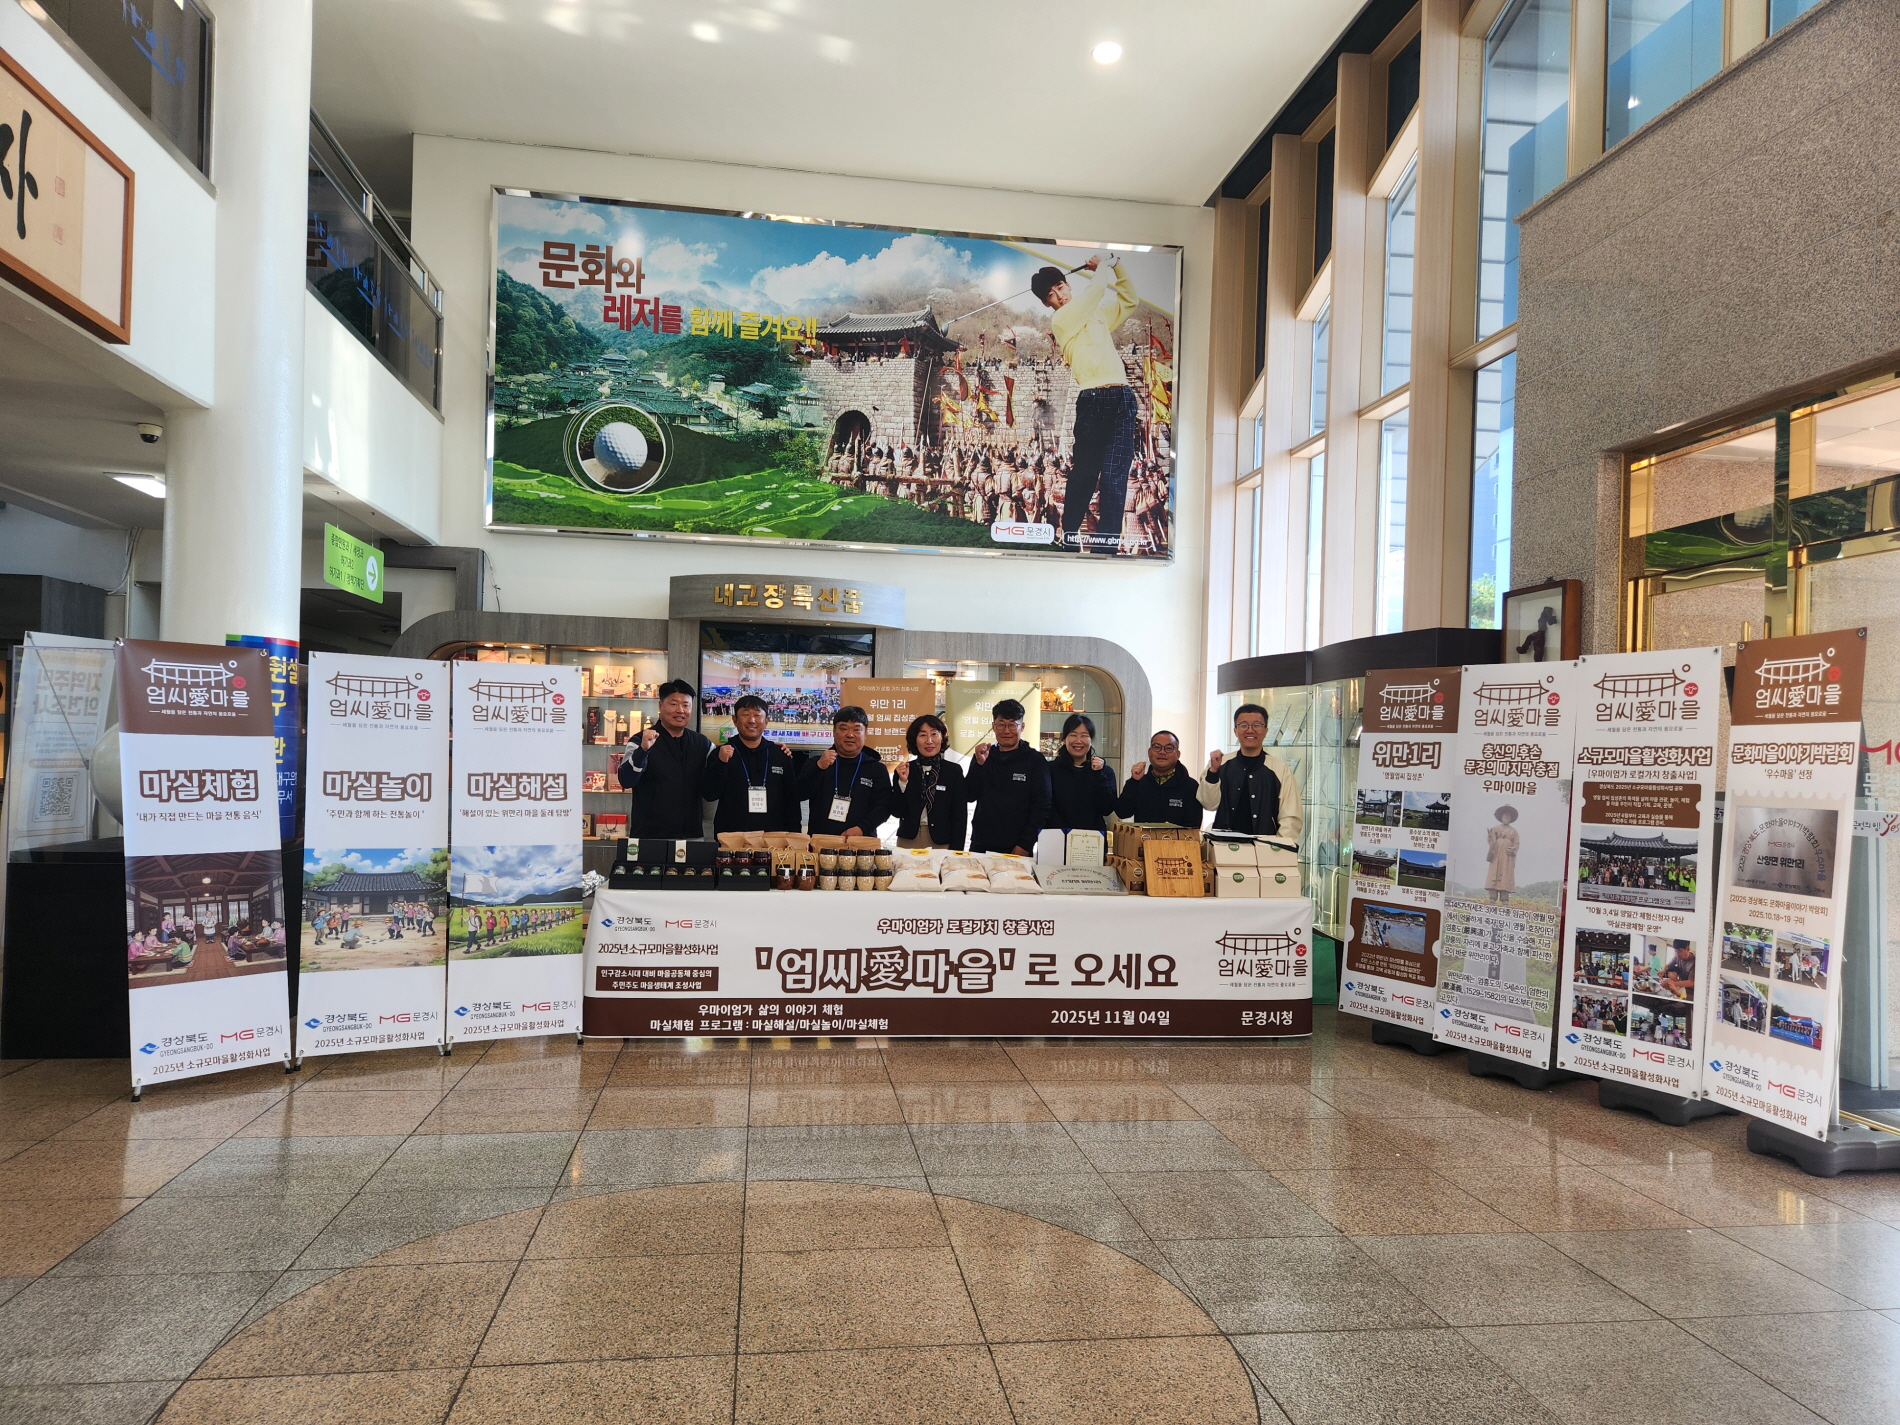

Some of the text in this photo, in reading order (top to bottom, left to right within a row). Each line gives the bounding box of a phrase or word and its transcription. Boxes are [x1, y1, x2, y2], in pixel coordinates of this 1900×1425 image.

[538, 240, 646, 294] 문화와
[603, 293, 818, 346] 레저를 함께 즐겨요!!
[995, 525, 1051, 537] MG 문경시
[146, 685, 250, 708] 엄씨愛마을
[869, 699, 906, 710] 위만 1리
[1755, 683, 1843, 709] 엄씨愛마을
[329, 698, 434, 721] 엄씨愛마을
[472, 704, 568, 724] 엄씨愛마을
[1379, 704, 1445, 723] 엄씨愛마을
[1474, 707, 1562, 728] 엄씨愛마을
[1595, 699, 1701, 722] 엄씨愛마을
[1482, 743, 1543, 761] 충신의 후손
[1577, 745, 1713, 767] 소규모마을활성화사업
[1731, 741, 1855, 765] 문화마을이야기박람회
[1463, 759, 1560, 779] 문경의 마지막 충절
[1587, 769, 1697, 781] [우마이엄가 로컬가치 창출사업]
[1764, 768, 1813, 780] '우수마을' 선정
[139, 769, 259, 803] 마실체험
[323, 770, 432, 802] 마실놀이
[467, 772, 568, 802] 마실해설
[1482, 780, 1538, 795] 우마이마을
[136, 809, 262, 822] '내가 직접 만드는 마을 전통 음식'
[326, 808, 420, 819] '주민과 함께 하는 전통놀이
[459, 808, 572, 818] '해설이 있는 위만리 마을 둘레 탐방'
[1756, 855, 1779, 866] 산양면
[1585, 906, 1685, 924] "10월 3,4일 양일간 체험신청자 대상
[1729, 893, 1829, 917] [2025 경상북도 문화마을이야기 박람회]
[616, 916, 717, 929] 경상북도 MG 문경시
[877, 918, 1055, 936] 우마이엄가 로컬가치 창출사업
[1748, 909, 1805, 926] 2025.10.18~19 구미
[600, 969, 713, 978] 인구감소시대 대비 마을공동체 중심의
[1024, 953, 1060, 986] 로
[1071, 953, 1179, 990] 오세요
[1217, 958, 1308, 979] 엄씨愛마을
[611, 981, 702, 990] 주민주도 마을생태계 조성사업
[1356, 981, 1386, 995] 경상북도
[1391, 993, 1415, 1006] MG
[1415, 998, 1435, 1010] 문경시
[471, 999, 577, 1013] 경상북도 MG 문경시
[697, 1003, 844, 1016] 우마이엄가 삶의 이야기 체험
[1349, 1000, 1424, 1025] 2025년 소규모마을활성화사업
[324, 1011, 438, 1025] 경상북도 MG 문경시
[462, 1018, 565, 1035] 2025년 소규모마을활성화사업
[650, 1018, 889, 1032] 마실체험 프로그램 마실해설/마실놀이/마실체험
[1051, 1010, 1170, 1026] 2025년 11월 04일
[1240, 1010, 1294, 1026] 문경시청
[1453, 1008, 1546, 1043] 경상북도 MG 문경시
[161, 1024, 283, 1047] 경상북도 MG 문경시
[314, 1031, 425, 1049] 2025년 소규모마을활성화사업
[1445, 1029, 1532, 1059] 2025년 소규모마을활성화사업
[152, 1047, 271, 1075] 2025년 소규모마을활성화사업
[1582, 1032, 1695, 1071] 경상북도 MG 문경시
[1573, 1055, 1680, 1089] 2025년 소규모마을활성화사업
[1724, 1059, 1823, 1108] 경상북도 MG 문경시
[1715, 1085, 1808, 1127] 2025년 소규모마을활성화사업
